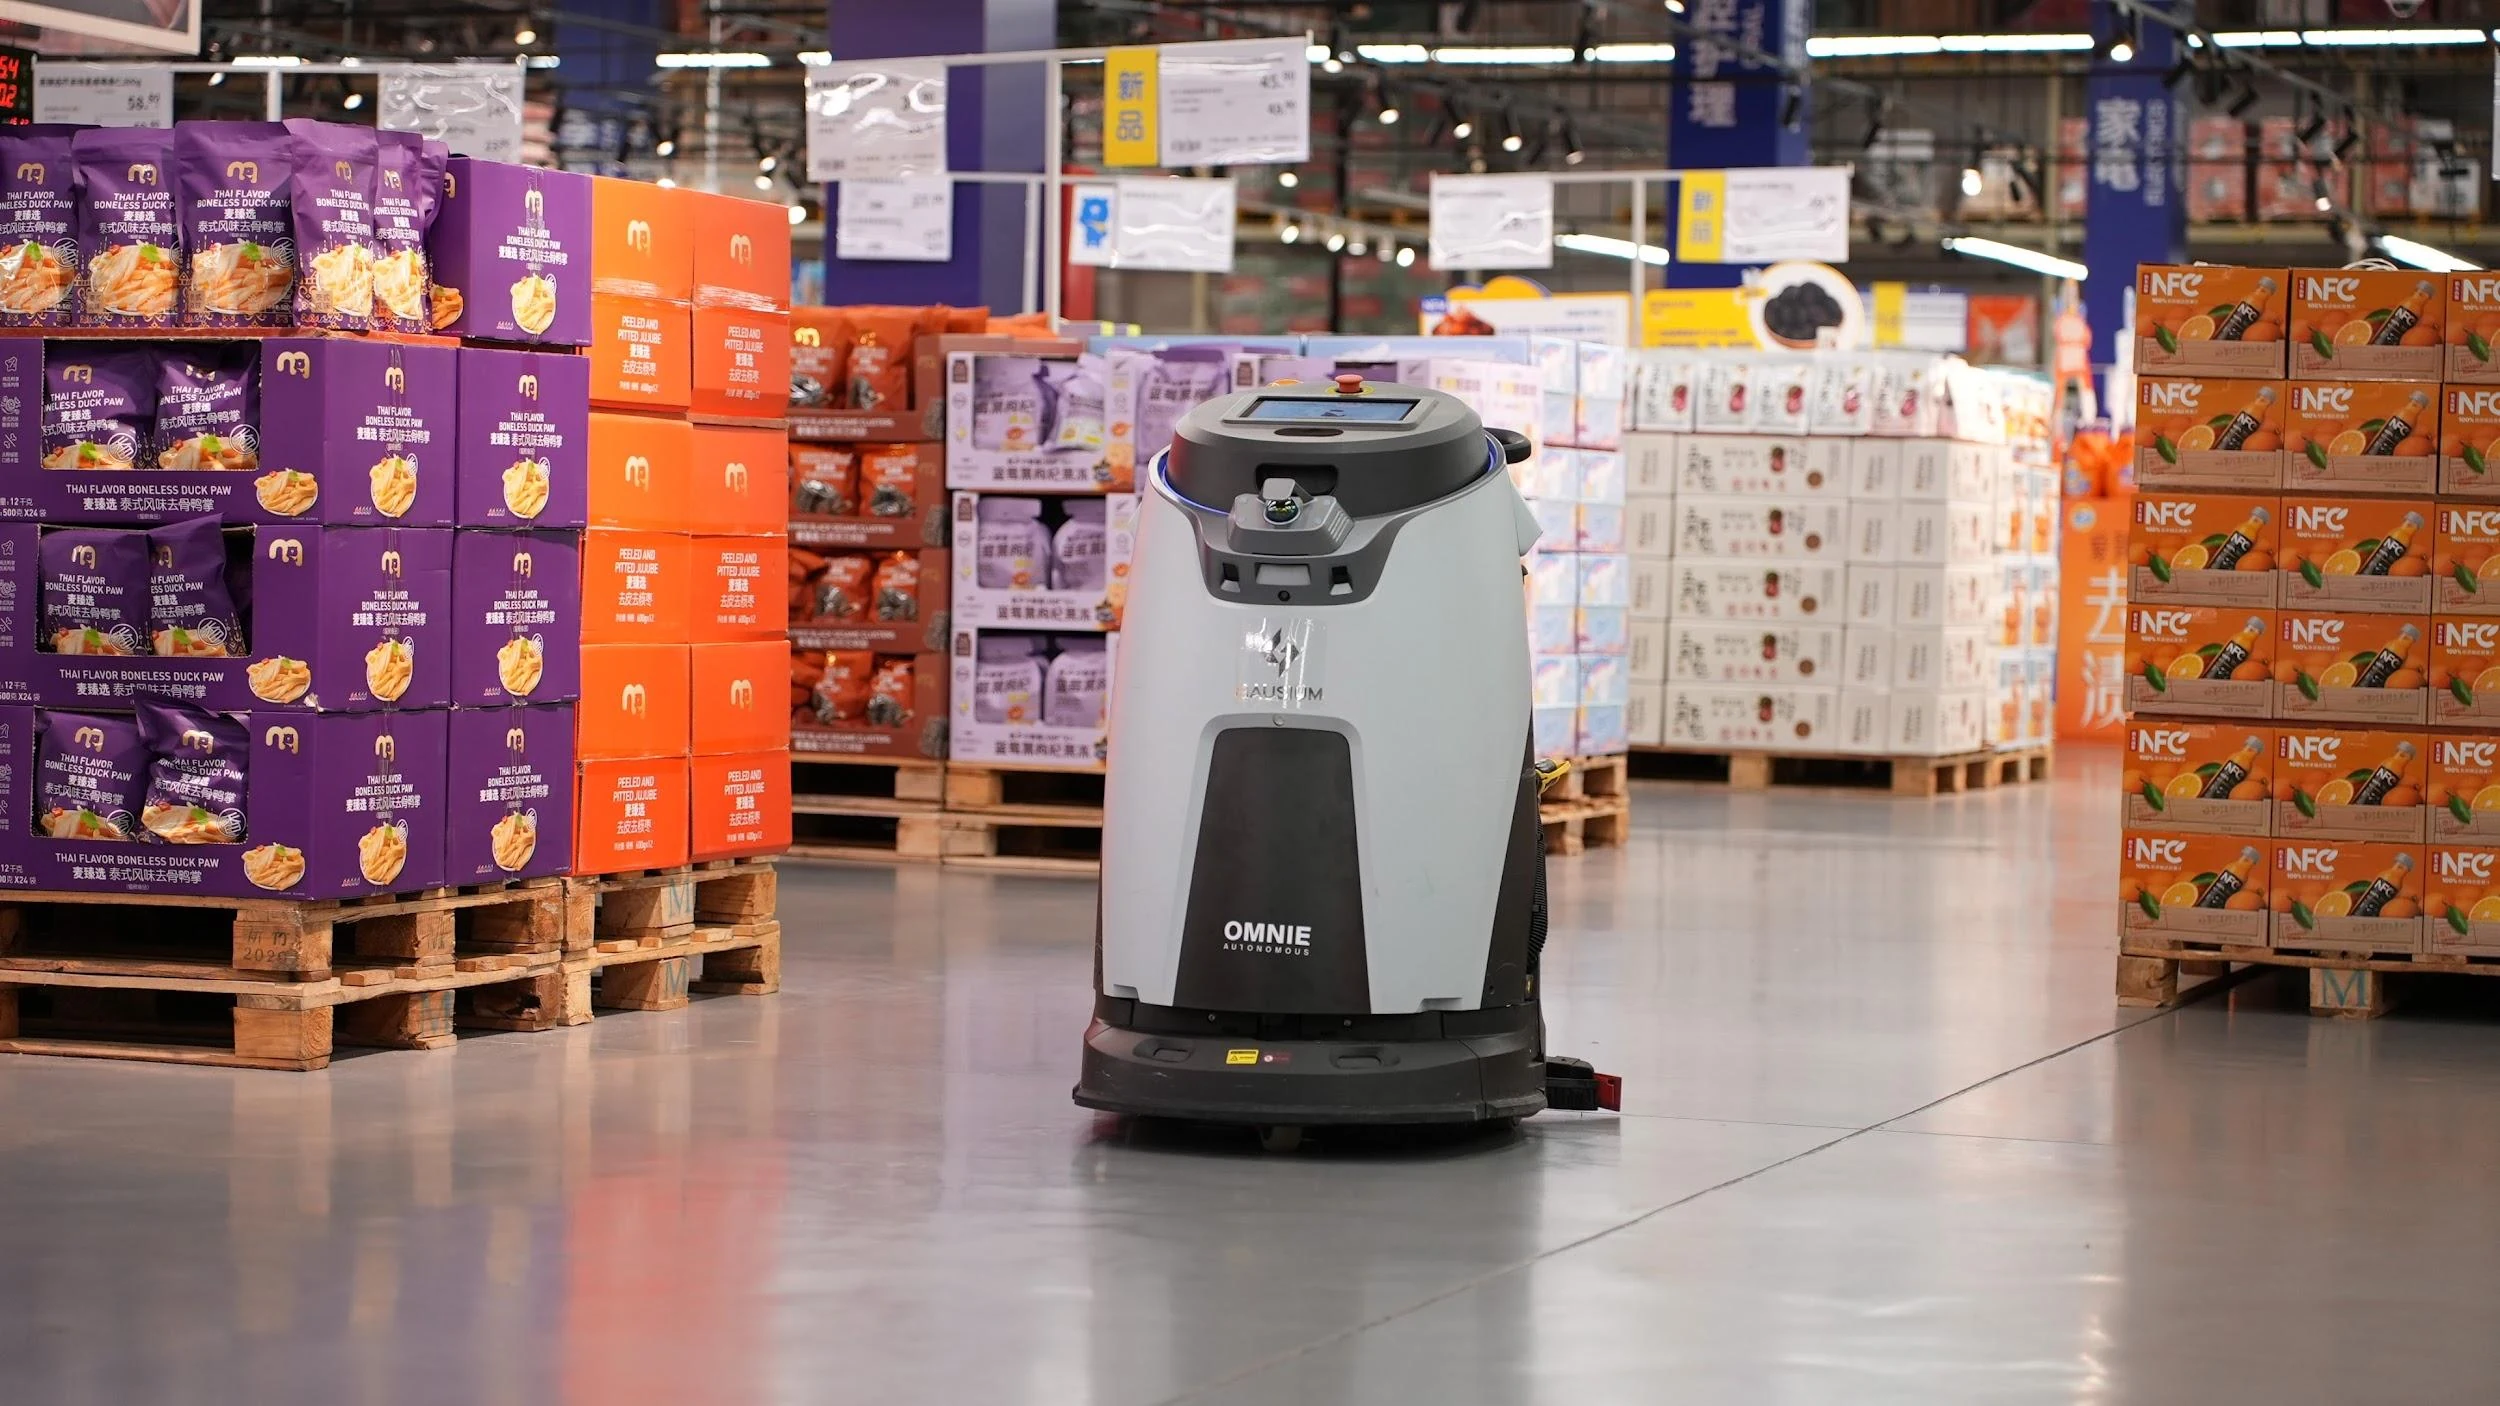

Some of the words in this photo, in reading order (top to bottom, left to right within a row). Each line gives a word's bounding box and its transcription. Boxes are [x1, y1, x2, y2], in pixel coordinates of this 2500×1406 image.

[2095, 96, 2141, 191] 家电
[7, 192, 22, 200] THAI
[136, 192, 170, 200] FLAVOR
[215, 190, 233, 198] THAI
[236, 190, 271, 199] FLAVOR
[29, 200, 51, 208] DUCK
[95, 201, 140, 209] BONELESS
[142, 201, 166, 209] DUCK
[197, 199, 239, 208] BONELESS
[242, 199, 267, 207] DUCK
[269, 200, 290, 208] PAW
[316, 199, 349, 208] BONELESS
[2152, 272, 2203, 297] NFC
[2307, 277, 2360, 302] NFC
[622, 316, 645, 328] PEELED
[618, 329, 641, 342] PITTED
[50, 392, 69, 401] THAI
[71, 389, 104, 399] FLAVOR
[171, 386, 191, 394] THAI
[2152, 382, 2202, 407] NFC
[78, 399, 102, 407] DUCK
[104, 398, 124, 407] PAW
[2301, 387, 2354, 411] NFC
[377, 406, 390, 416] THAI
[391, 406, 411, 417] FLAVOR
[510, 412, 523, 422] THAI
[524, 413, 544, 423] FLAVOR
[365, 416, 394, 426] BONELESS
[395, 417, 410, 428] DUCK
[411, 418, 423, 428] PAW
[499, 422, 527, 432] BONELESS
[528, 423, 542, 433] DUCK
[543, 423, 555, 433] PAW
[66, 485, 87, 494] THAI
[90, 485, 126, 494] FLAVOR
[129, 485, 179, 495] BONELESS
[182, 485, 207, 495] DUCK
[210, 486, 232, 495] PAW
[83, 498, 117, 511] 麦臻选
[120, 498, 214, 512] 泰式风味去骨鸭掌
[2145, 501, 2196, 526] NFC
[2297, 506, 2348, 532] NFC
[2450, 511, 2500, 535] NFC
[619, 548, 642, 559] PEELED
[615, 562, 636, 573] PITTED
[59, 574, 75, 582] THAI
[77, 575, 106, 585] FLAVOR
[158, 574, 185, 584] FLAVOR
[45, 582, 80, 592] BONELESS
[82, 584, 103, 594] DUCK
[106, 586, 123, 595] PAW
[164, 584, 184, 592] DUCK
[186, 582, 203, 591] PAW
[374, 590, 386, 600] THAI
[388, 590, 408, 600] FLAVOR
[505, 590, 517, 599] THAI
[518, 590, 538, 600] FLAVOR
[361, 601, 391, 611] BONELESS
[392, 601, 406, 611] DUCK
[407, 602, 419, 611] PAW
[493, 600, 521, 610] BONELESS
[522, 600, 536, 610] DUCK
[537, 600, 548, 610] PAW
[2141, 610, 2192, 636] NFC
[2292, 619, 2344, 644] NFC
[2446, 623, 2499, 648] NFC
[59, 669, 81, 679] THAI
[83, 669, 118, 680] FLAVOR
[121, 670, 171, 681] BONELESS
[174, 671, 199, 681] DUCK
[203, 672, 224, 682] PAW
[76, 683, 110, 696] 麦臻选
[2139, 729, 2190, 755] NFC
[2288, 736, 2341, 761] NFC
[2444, 741, 2496, 766] NFC
[60, 753, 78, 764] THAI
[80, 757, 113, 769] FLAVOR
[193, 759, 225, 767] FLAVOR
[45, 760, 83, 776] BONELESS
[85, 767, 109, 778] DUCK
[111, 771, 132, 782] PAW
[200, 768, 222, 776] DUCK
[223, 769, 244, 780] PAW
[499, 766, 511, 776] THAI
[512, 765, 531, 775] FLAVOR
[367, 774, 380, 785] THAI
[381, 774, 402, 784] FLAVOR
[487, 776, 514, 787] BONELESS
[516, 775, 529, 785] DUCK
[530, 774, 541, 784] PAW
[618, 777, 640, 788] PEELED
[355, 785, 385, 796] BONELESS
[385, 784, 400, 794] DUCK
[401, 783, 414, 794] PAW
[613, 790, 634, 802] PITTED
[2136, 838, 2188, 864] NFC
[56, 853, 77, 863] THAI
[79, 854, 114, 865] FLAVOR
[117, 855, 166, 867] BONELESS
[169, 857, 195, 867] DUCK
[198, 858, 219, 868] PAW
[2287, 848, 2338, 873] NFC
[2442, 852, 2495, 877] NFC
[72, 867, 106, 881] 麦臻选
[109, 868, 202, 883] 泰式风味去骨鸭掌
[1224, 920, 1311, 946] OMNIE
[1223, 943, 1310, 956] AUTONOMOUS
[2321, 969, 2368, 1007] M
